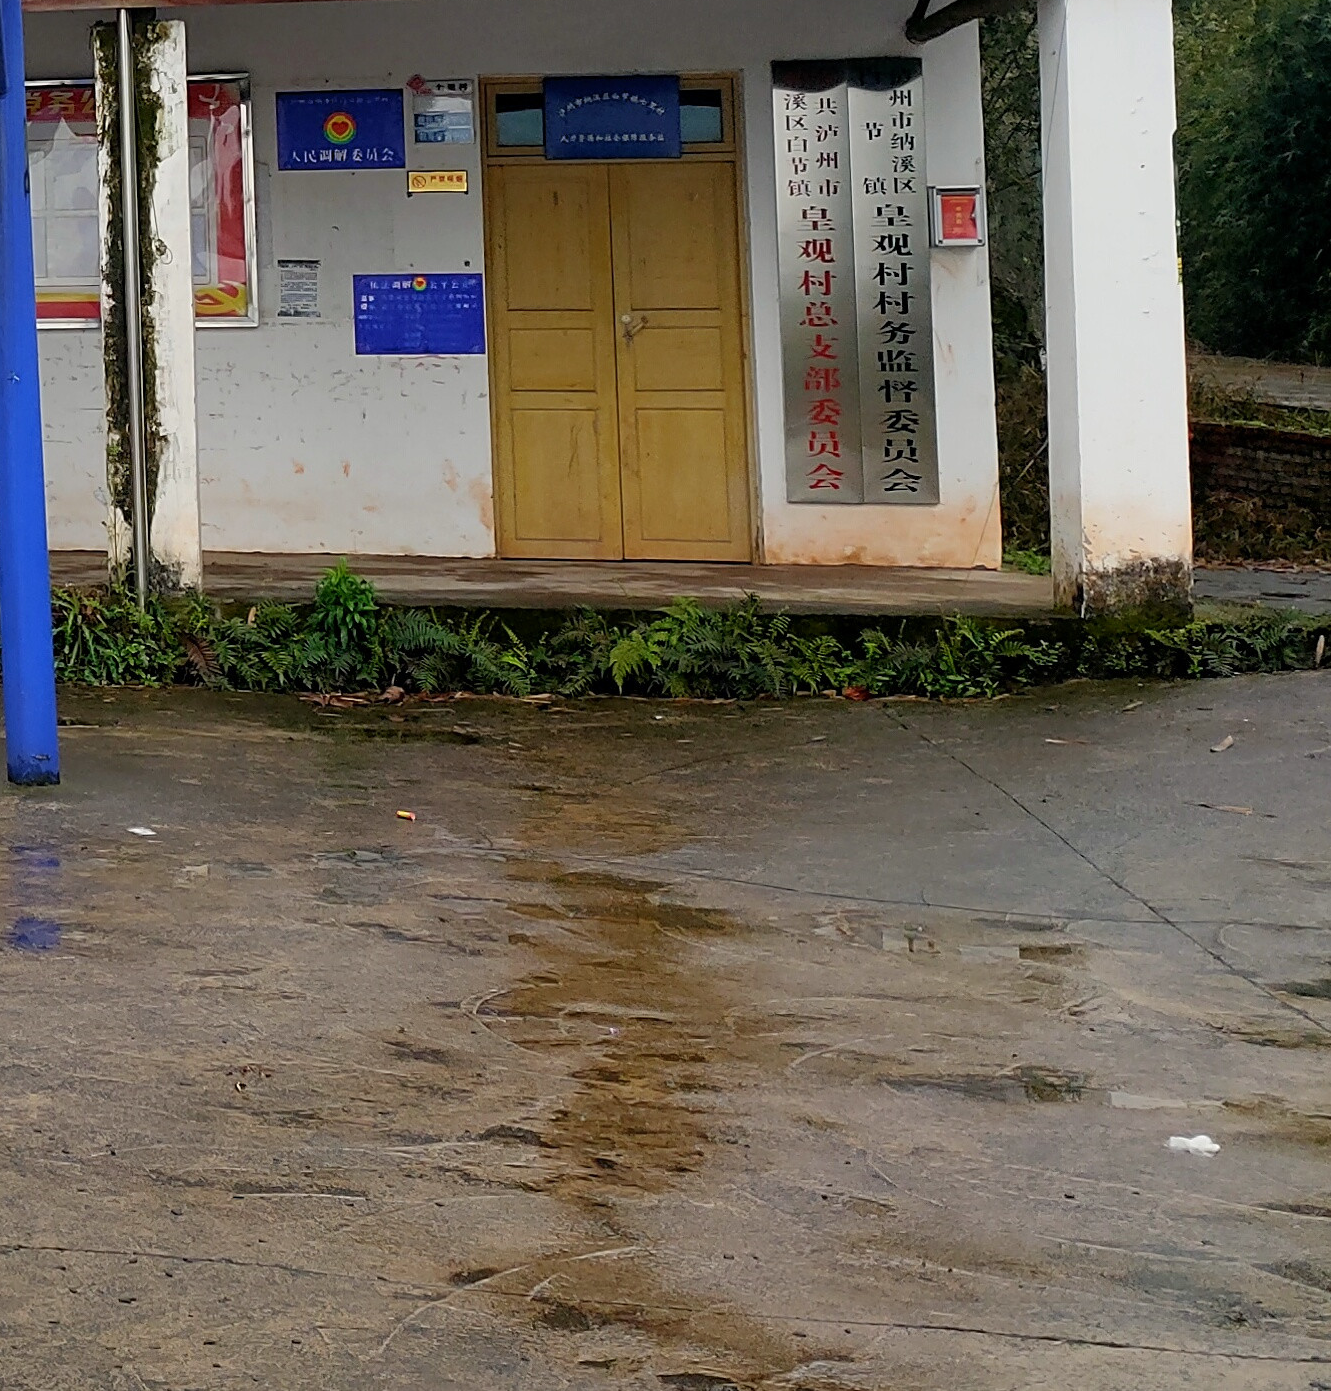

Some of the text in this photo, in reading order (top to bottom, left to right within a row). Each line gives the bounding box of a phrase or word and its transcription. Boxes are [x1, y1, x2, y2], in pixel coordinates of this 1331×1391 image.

[292, 147, 395, 163] 人民调解委员会
[783, 92, 813, 198] 溪区白节镇
[814, 94, 842, 198] 共泸州市
[888, 89, 918, 195] 州市纳溪区
[795, 203, 845, 491] 皇观村总支部委员会
[870, 202, 924, 494] 皇观村村务监督委员会
